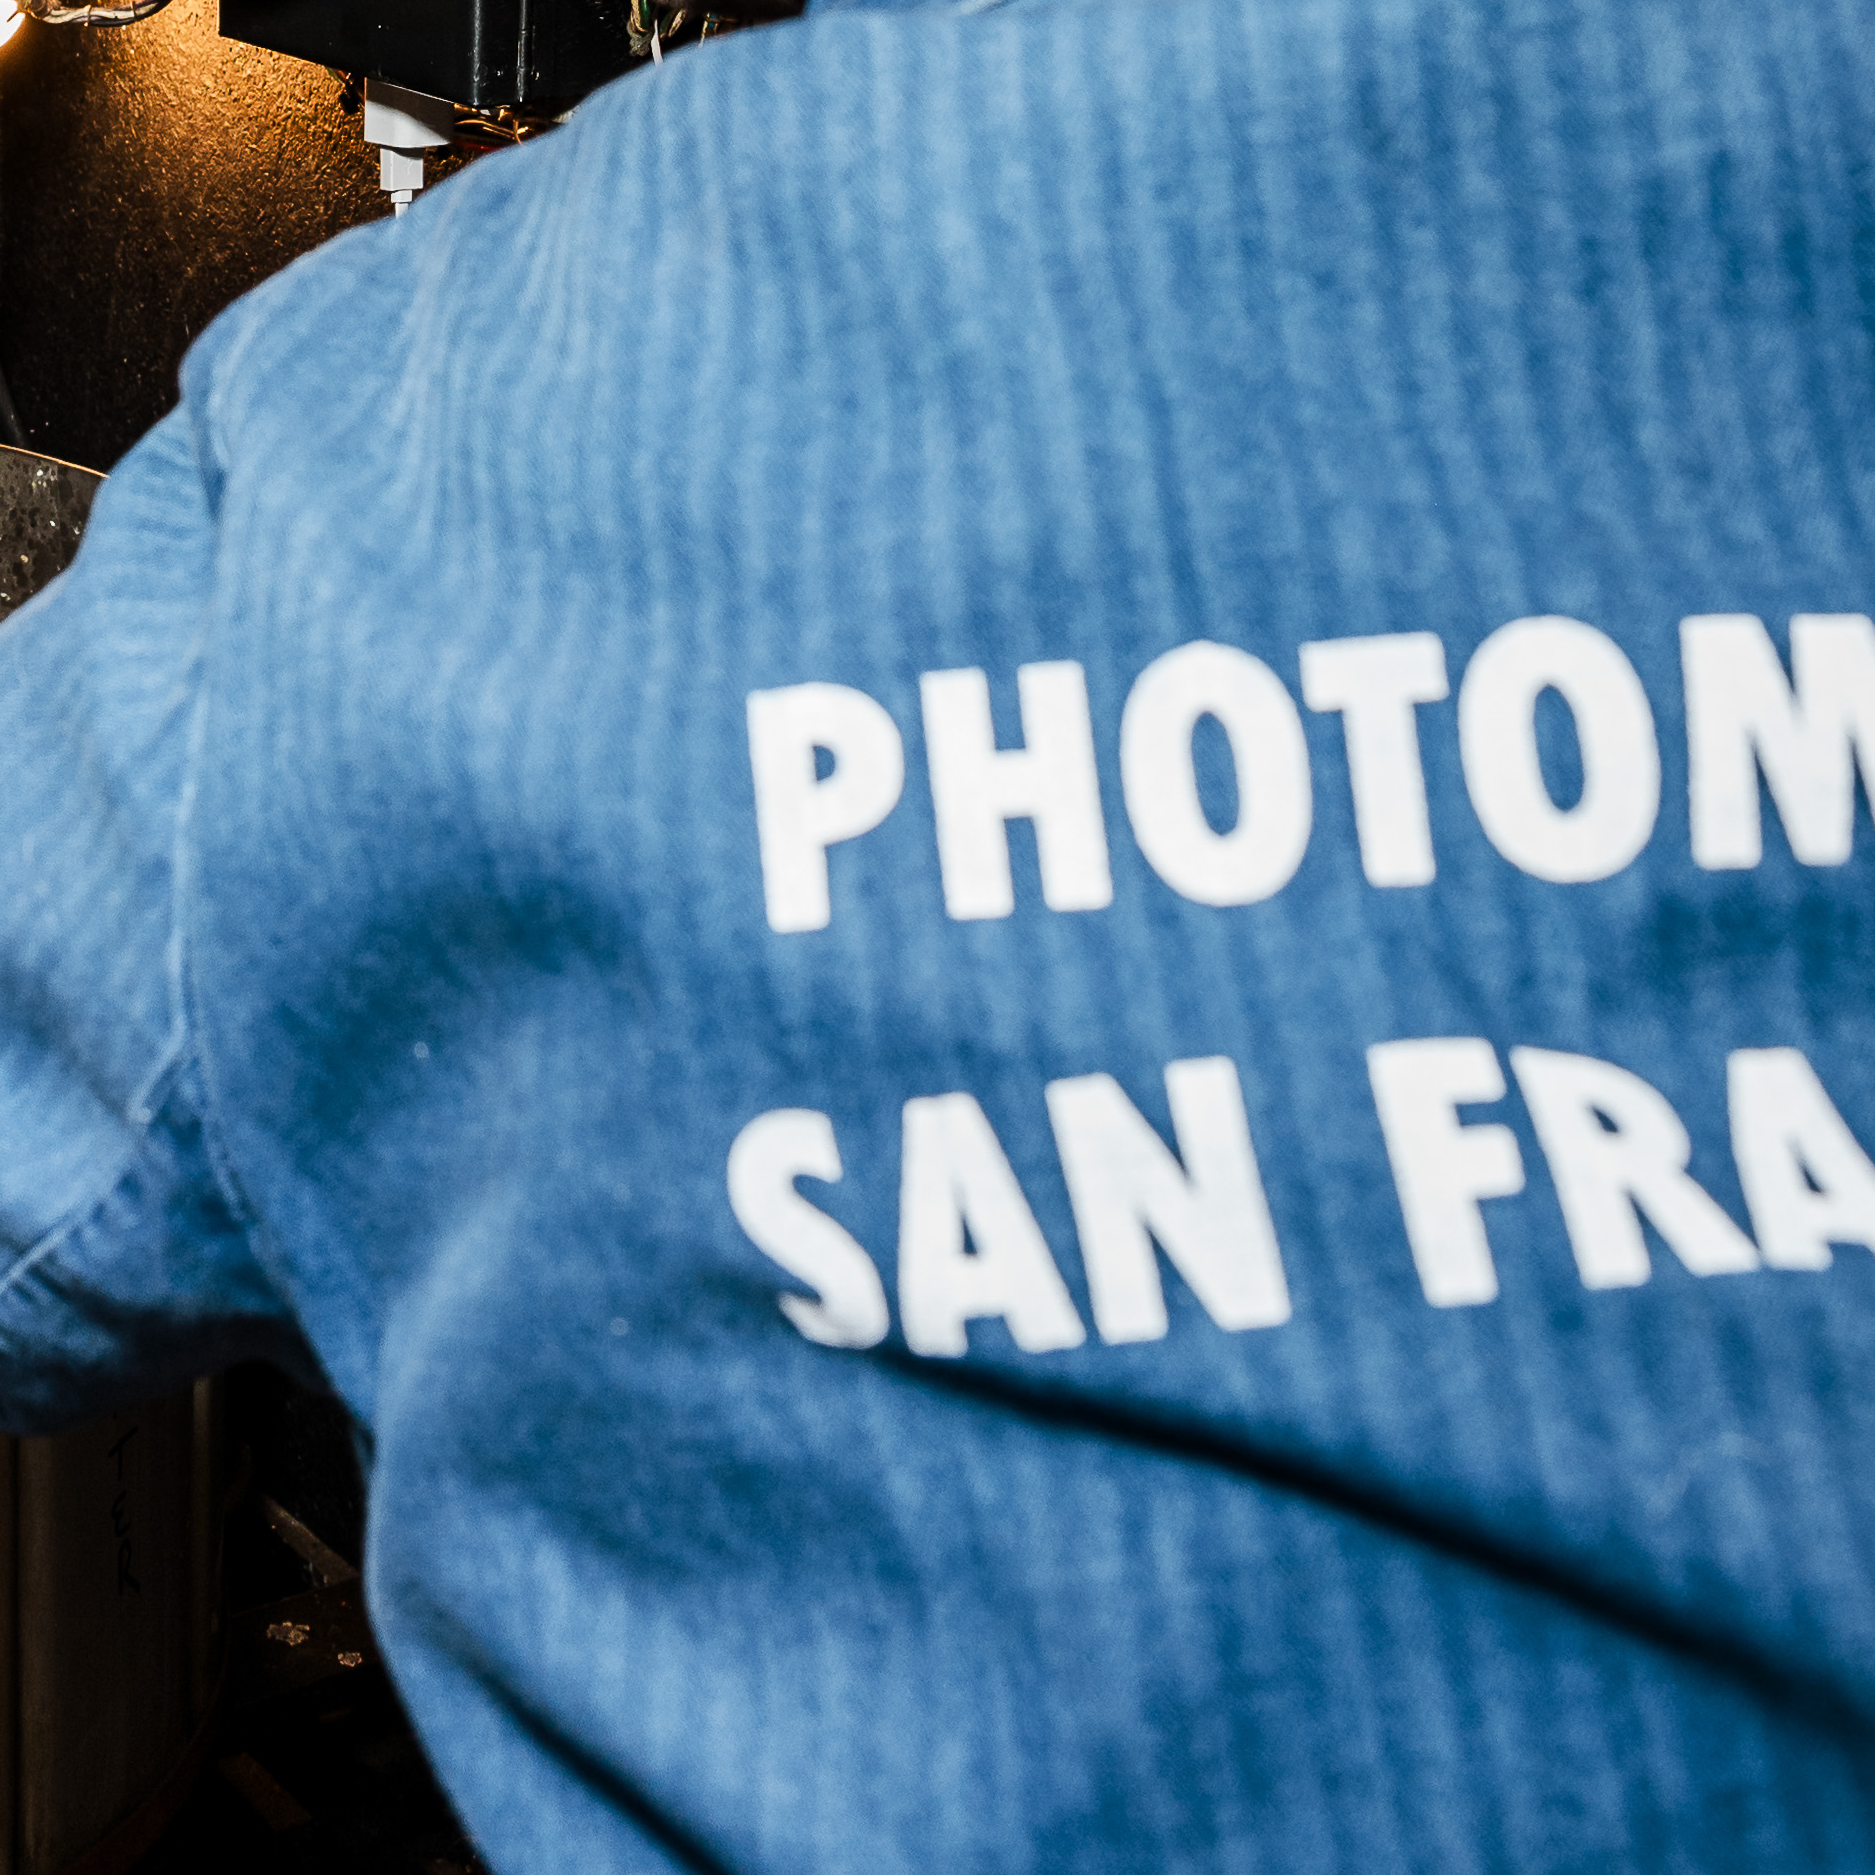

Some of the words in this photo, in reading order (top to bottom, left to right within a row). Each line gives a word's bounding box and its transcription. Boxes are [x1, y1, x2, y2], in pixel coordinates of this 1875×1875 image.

[746, 613, 1875, 933] PHOTOM
[727, 1054, 1292, 1357] SAN
[1366, 1037, 1875, 1307] FRA
